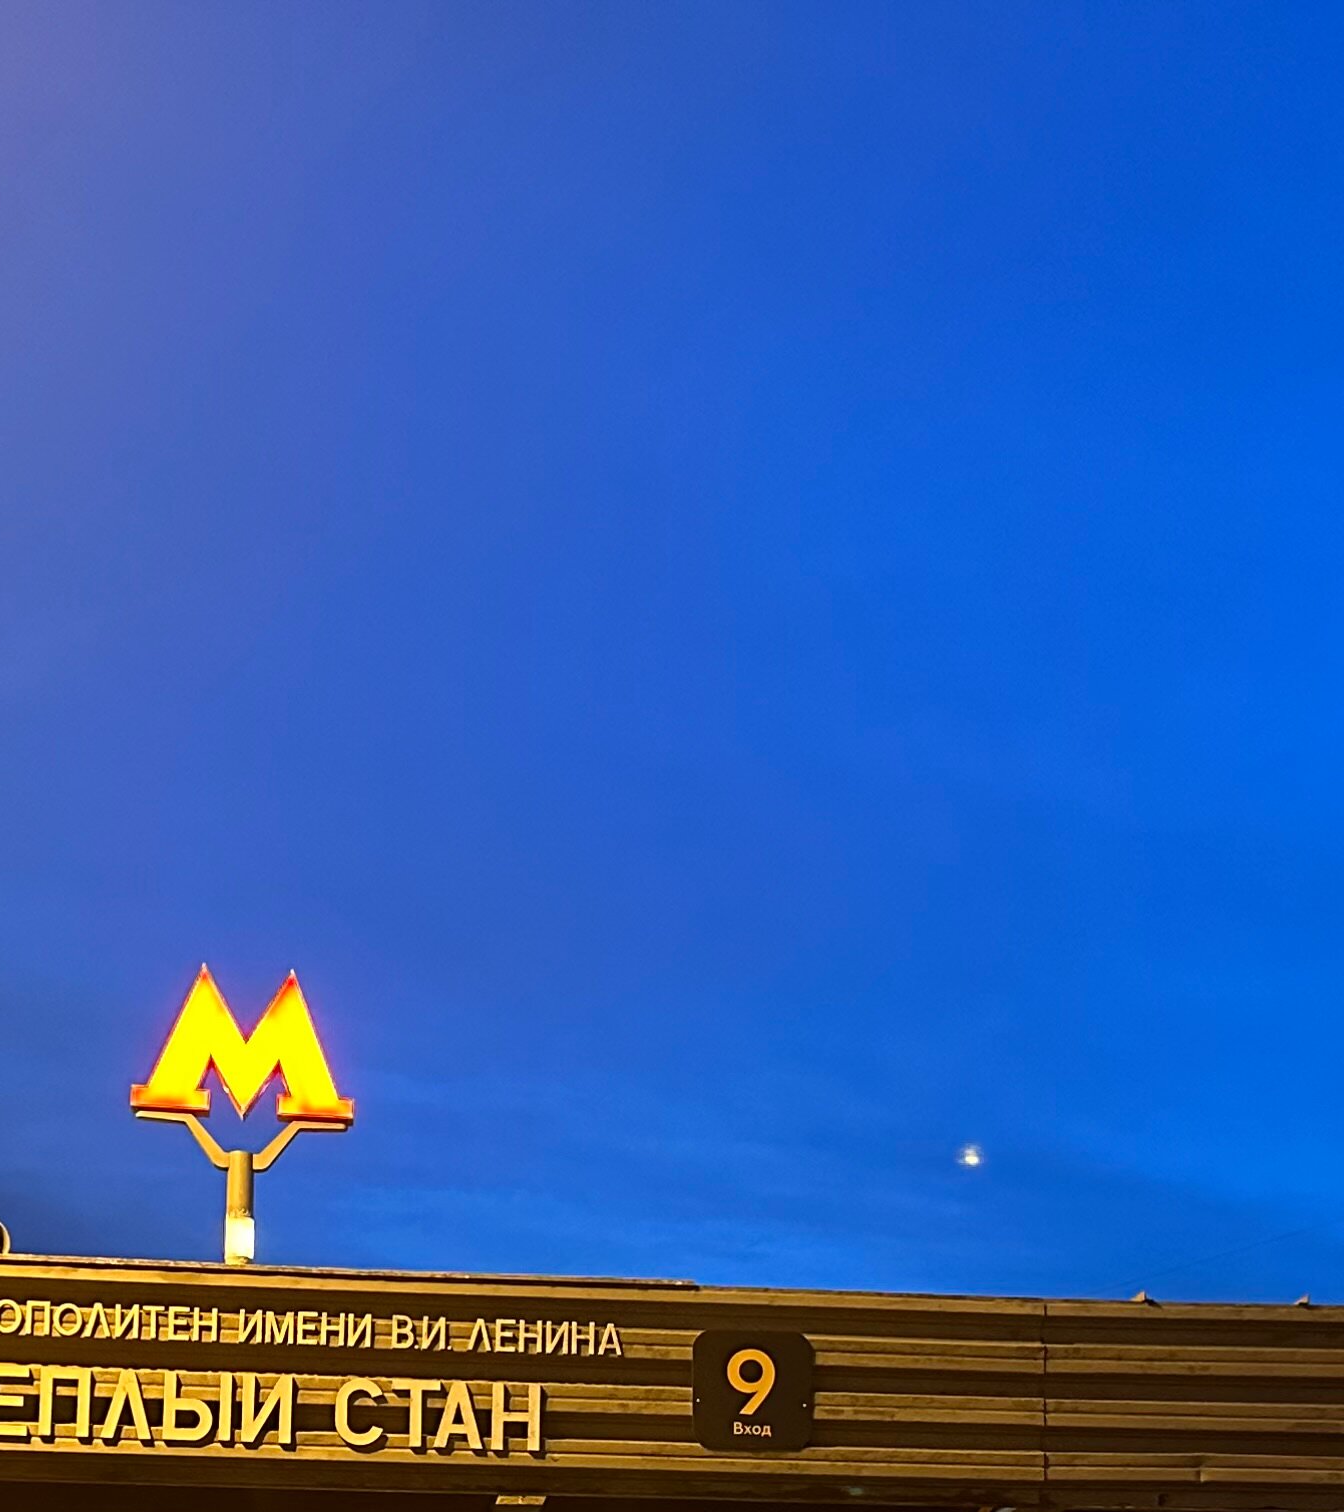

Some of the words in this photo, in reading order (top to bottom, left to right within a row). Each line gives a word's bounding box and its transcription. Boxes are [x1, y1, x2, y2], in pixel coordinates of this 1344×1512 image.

[238, 1308, 373, 1349] ИМЕНИ
[391, 1314, 453, 1351] В.И.
[467, 1317, 623, 1356] ЛЕНИНА
[726, 1348, 776, 1415] 9
[334, 1376, 544, 1453] СТАН
[733, 1421, 772, 1437] Вход
